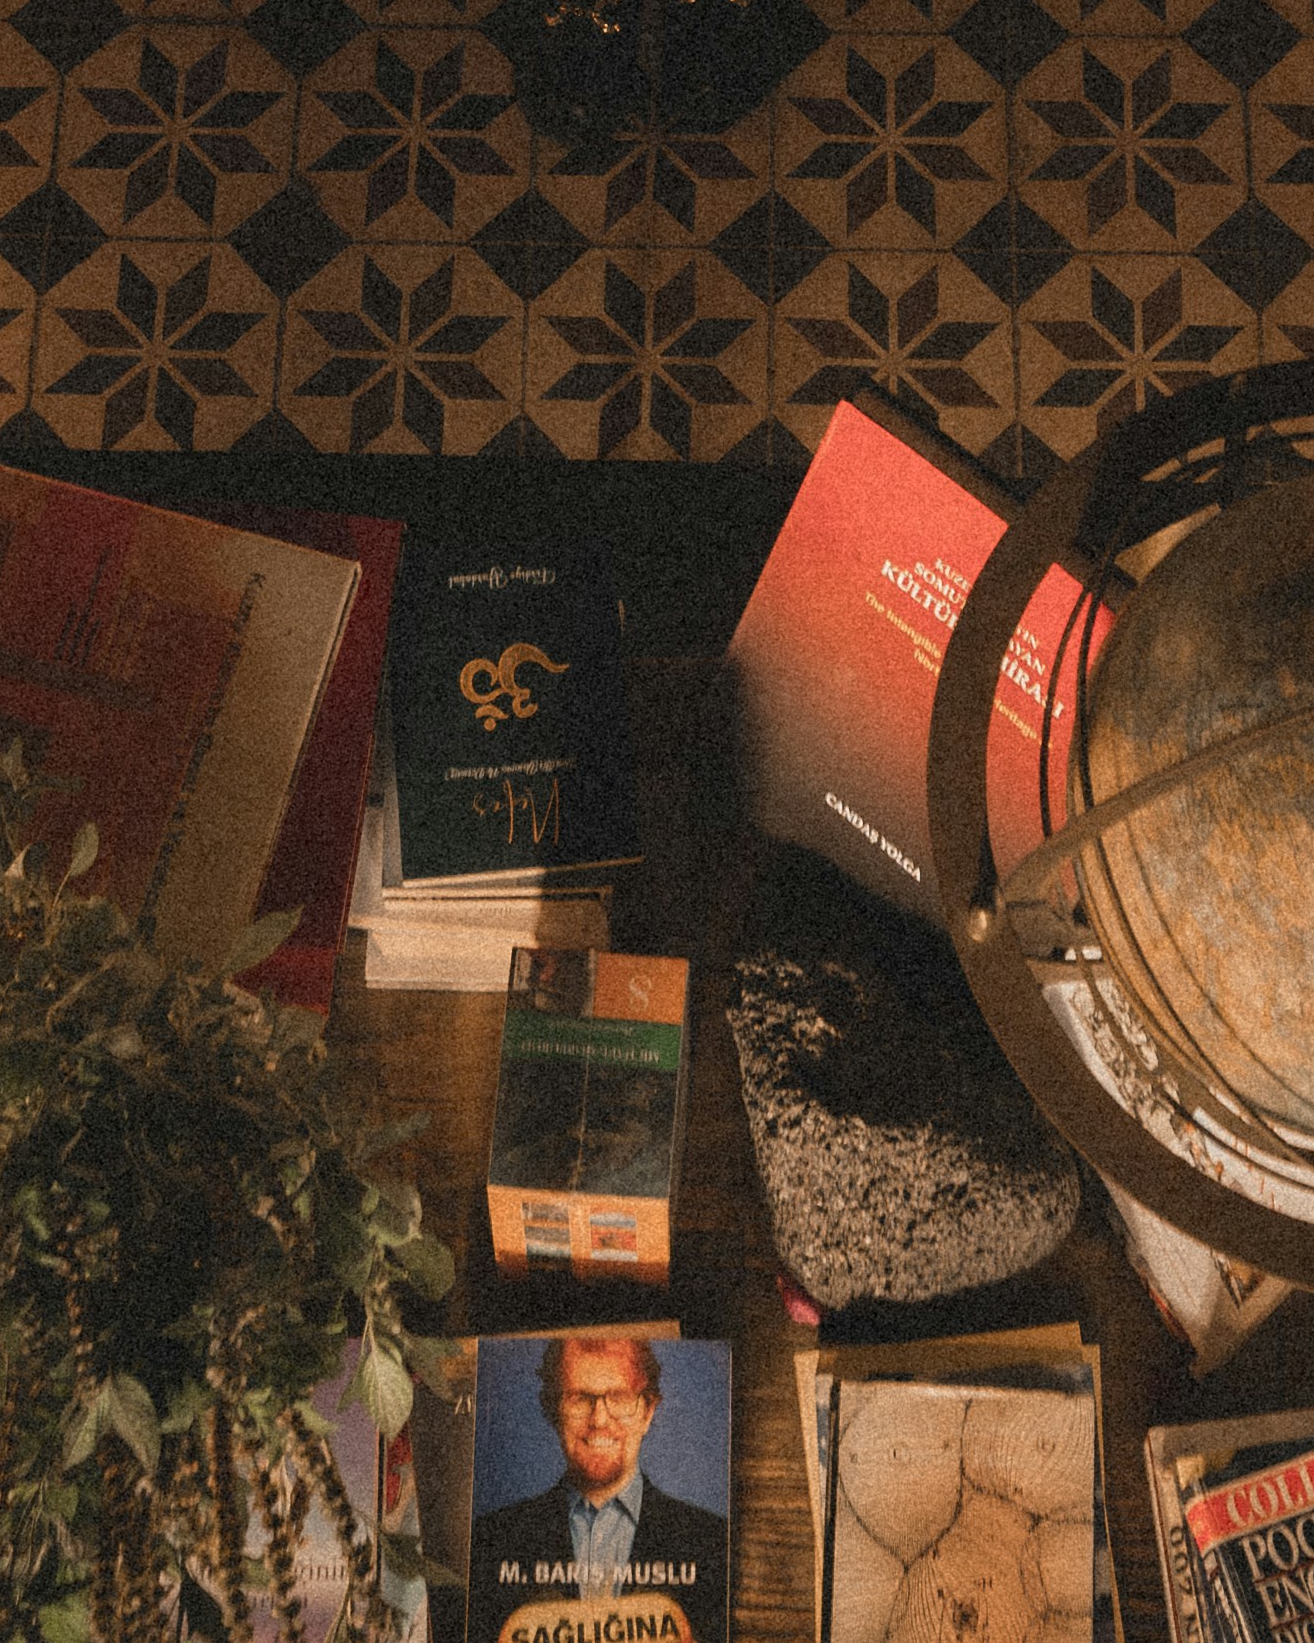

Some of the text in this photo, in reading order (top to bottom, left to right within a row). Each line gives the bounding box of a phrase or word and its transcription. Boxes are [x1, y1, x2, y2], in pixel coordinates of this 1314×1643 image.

[934, 557, 974, 592] KUZE
[1000, 655, 1065, 719] MİRAI
[824, 791, 922, 883] CANDAŞ YOLGA
[498, 1560, 697, 1589] M. BARIŞ MUSLU
[511, 1613, 681, 1643] SAĞLIĞINA
